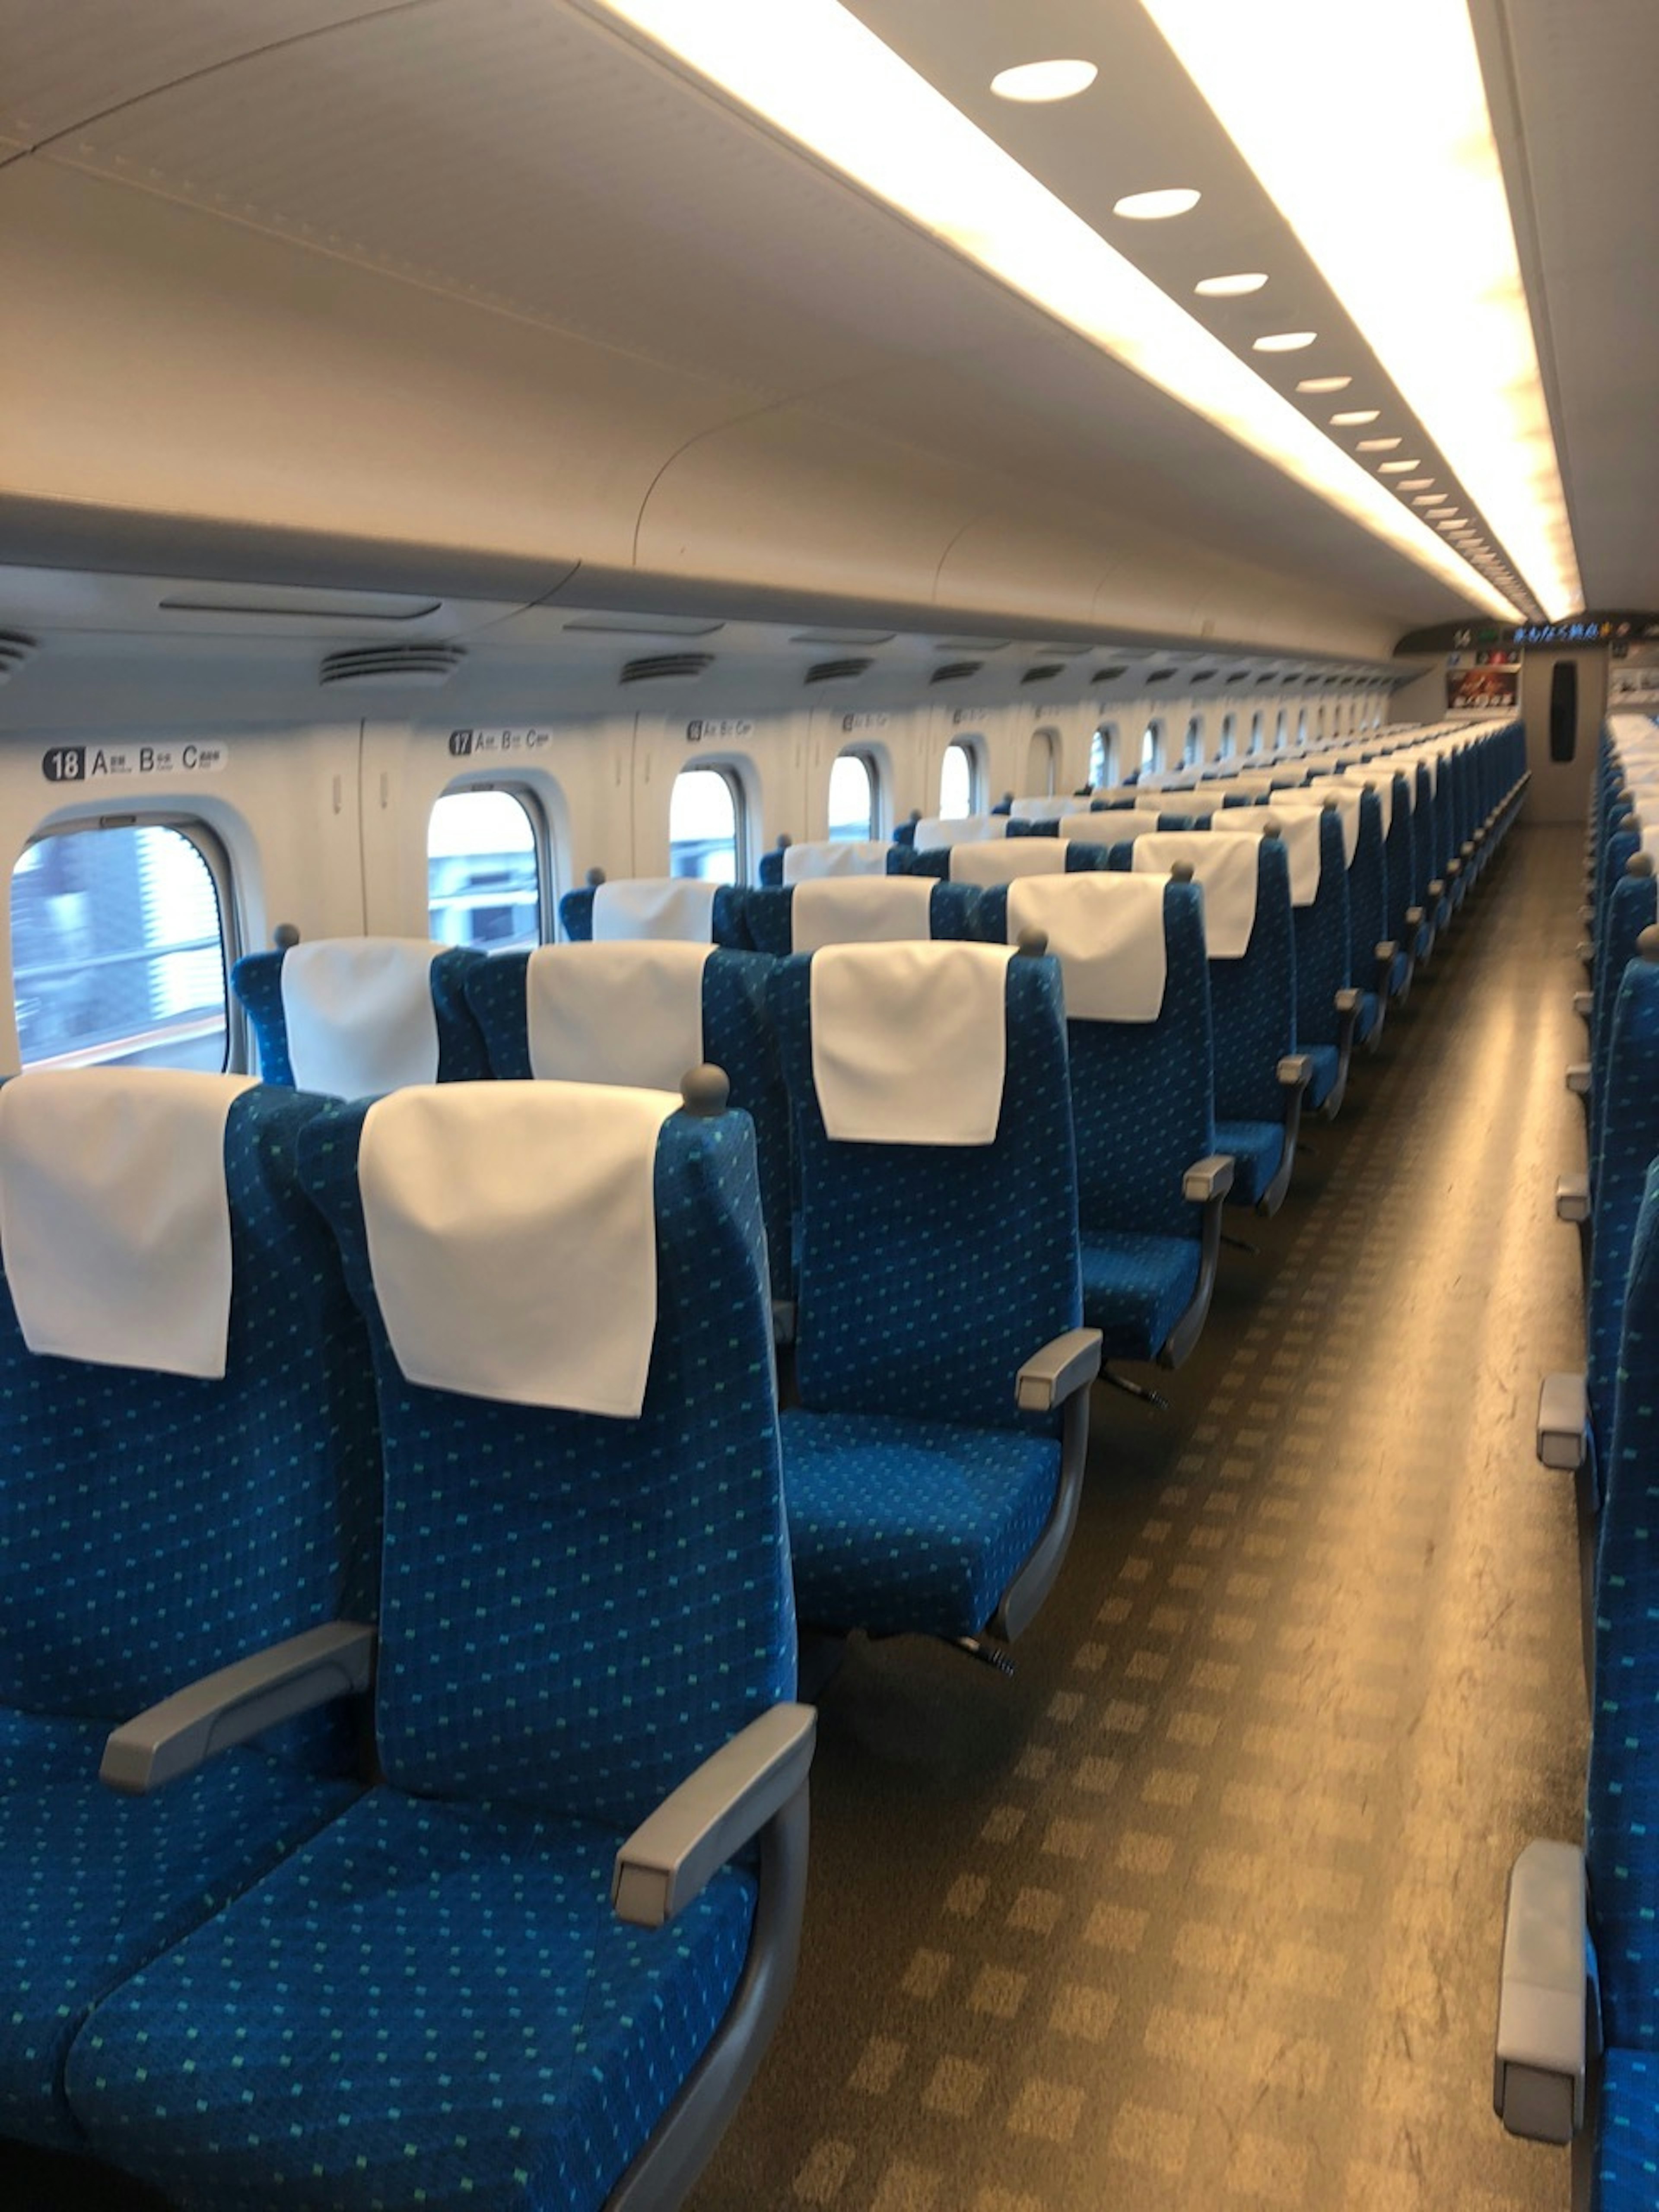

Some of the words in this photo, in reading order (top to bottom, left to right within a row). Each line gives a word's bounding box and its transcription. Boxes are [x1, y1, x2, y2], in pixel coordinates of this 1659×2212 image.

[455, 733, 470, 754] 17
[476, 732, 484, 751] A
[502, 731, 511, 749] B
[527, 729, 536, 747] C
[52, 751, 79, 779] 18
[92, 750, 108, 775] A
[140, 747, 154, 772] B
[183, 745, 197, 769] C
